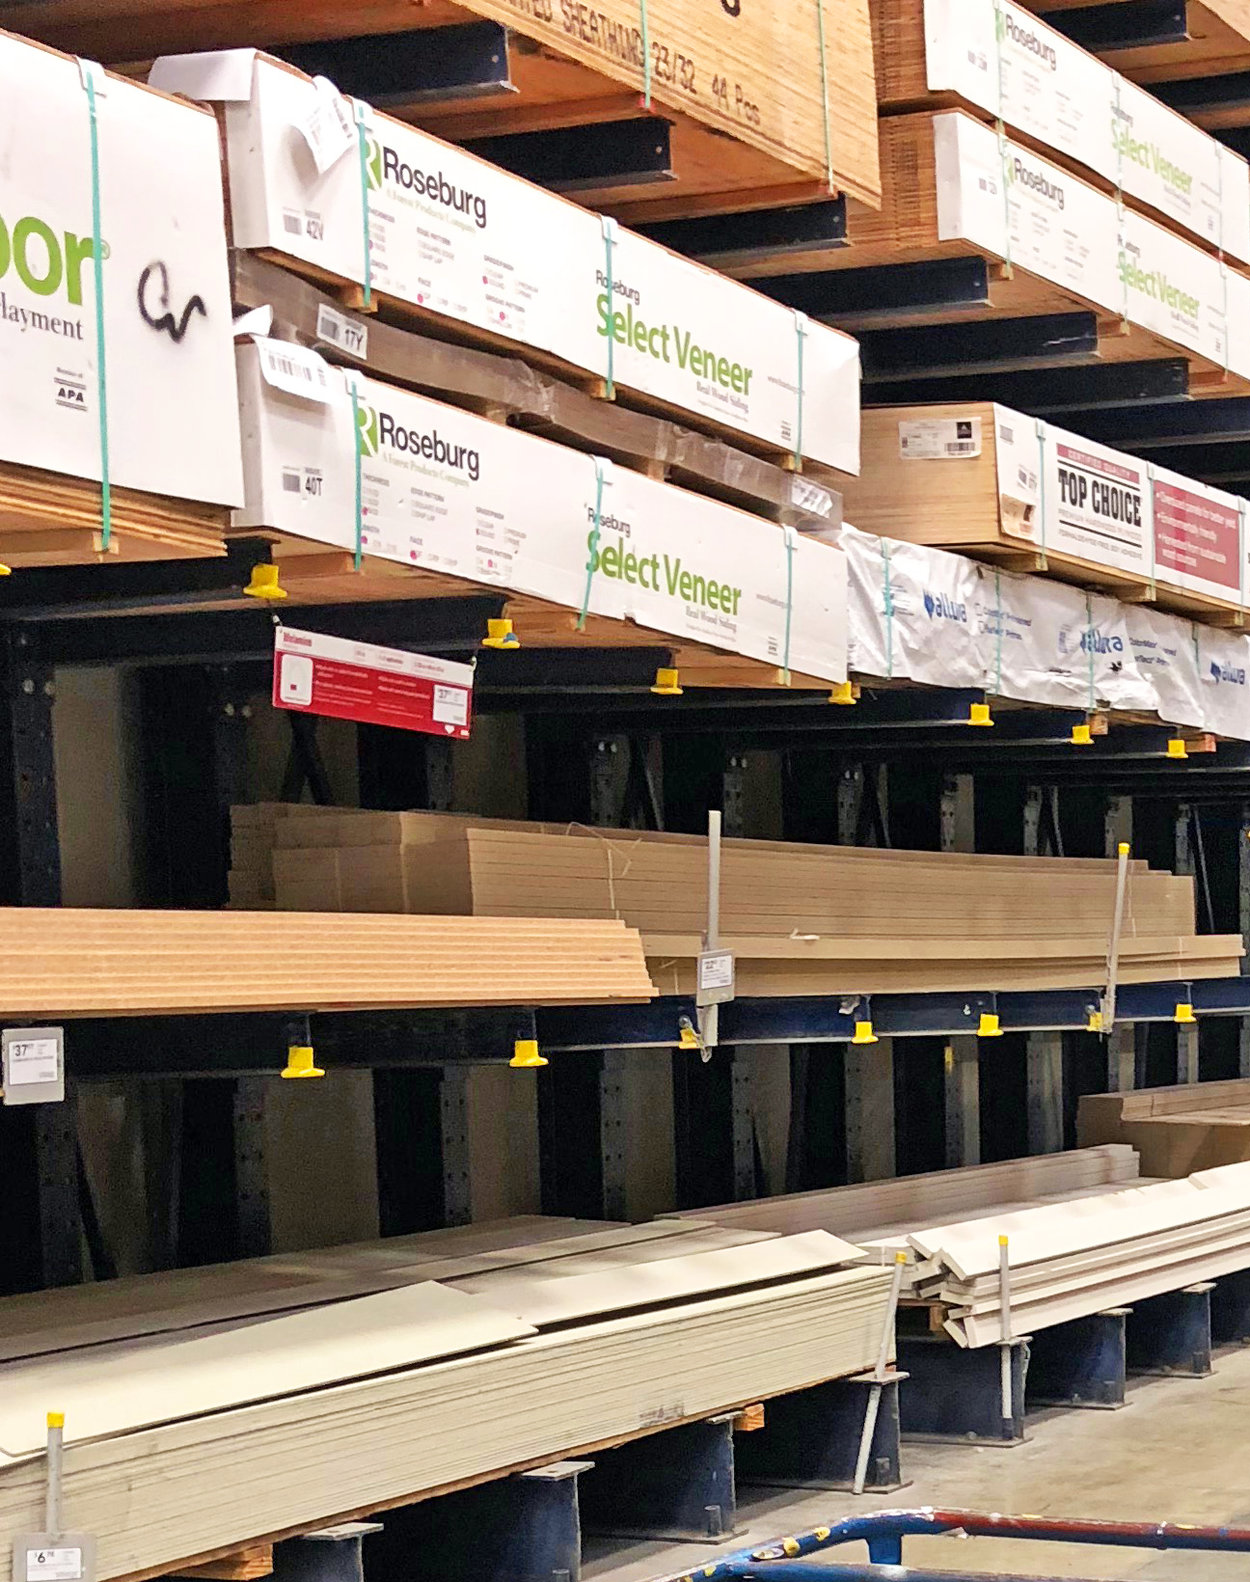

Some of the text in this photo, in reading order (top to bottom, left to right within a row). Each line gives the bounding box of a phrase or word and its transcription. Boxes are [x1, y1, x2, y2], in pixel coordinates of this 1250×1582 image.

[383, 146, 487, 228] Roseburg
[1014, 158, 1064, 211] Roseburg
[0, 214, 107, 306] or
[595, 269, 640, 305] Roeburg
[0, 292, 84, 340] layment
[596, 294, 752, 396] Select Veneer
[58, 387, 85, 403] APA
[379, 412, 480, 481] Roseburg
[587, 507, 631, 538] Rseburg
[1058, 467, 1087, 509] TOP
[1092, 480, 1142, 528] CHOICE
[586, 530, 741, 617] Select Veneer
